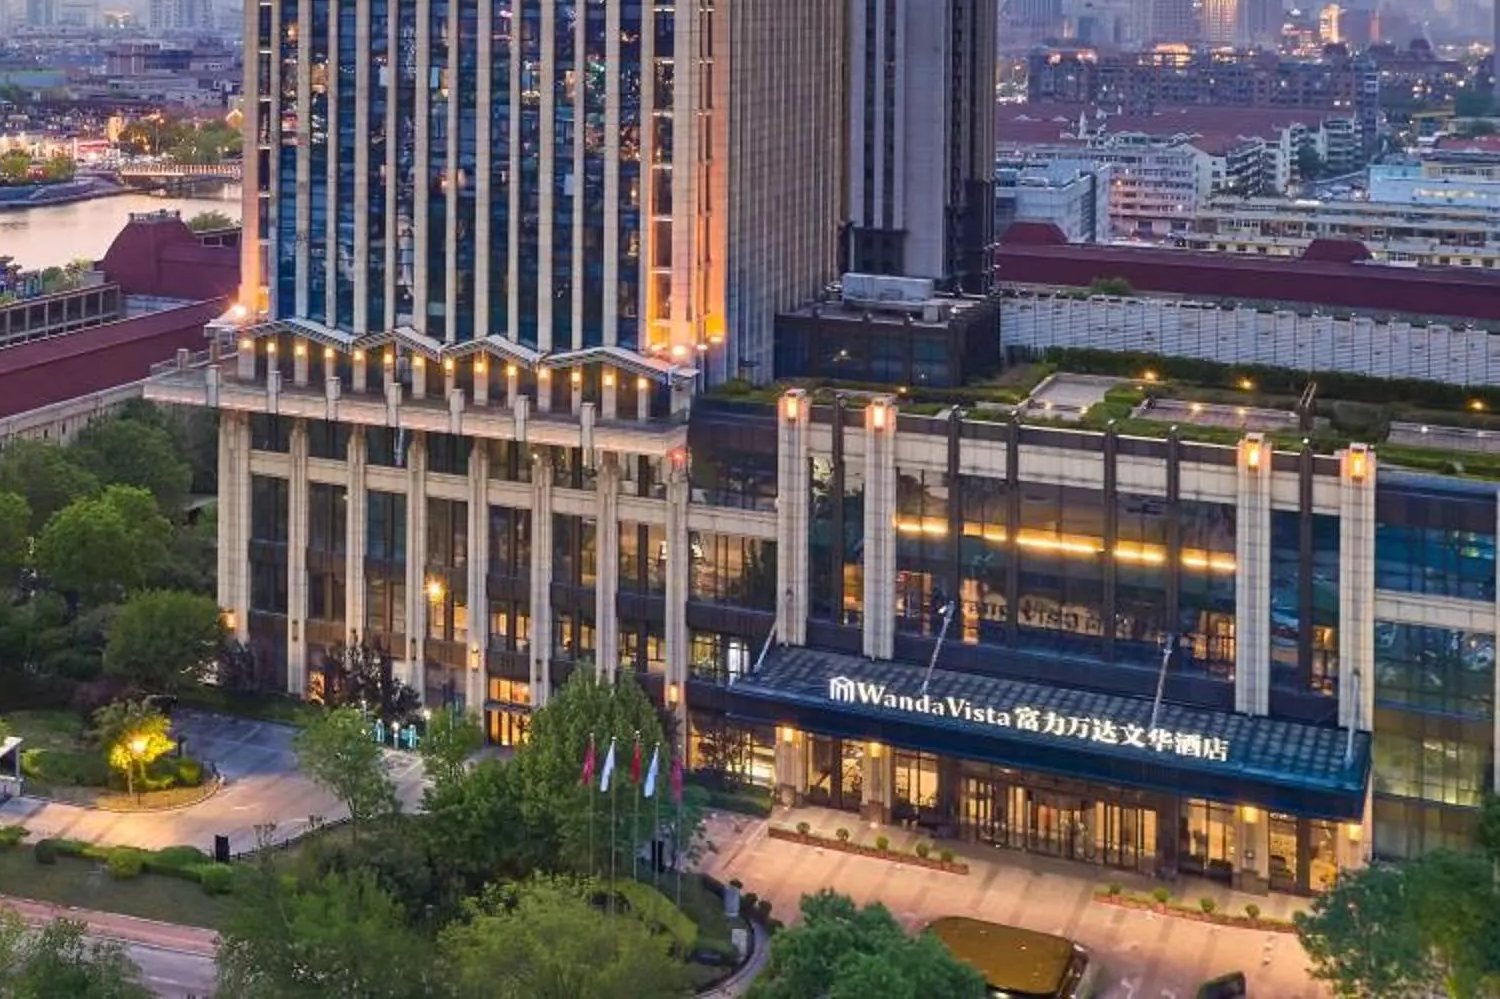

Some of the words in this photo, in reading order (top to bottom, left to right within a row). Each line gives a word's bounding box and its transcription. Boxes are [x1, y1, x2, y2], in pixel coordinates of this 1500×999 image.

[1014, 706, 1229, 762] 富力万达文华酒店
